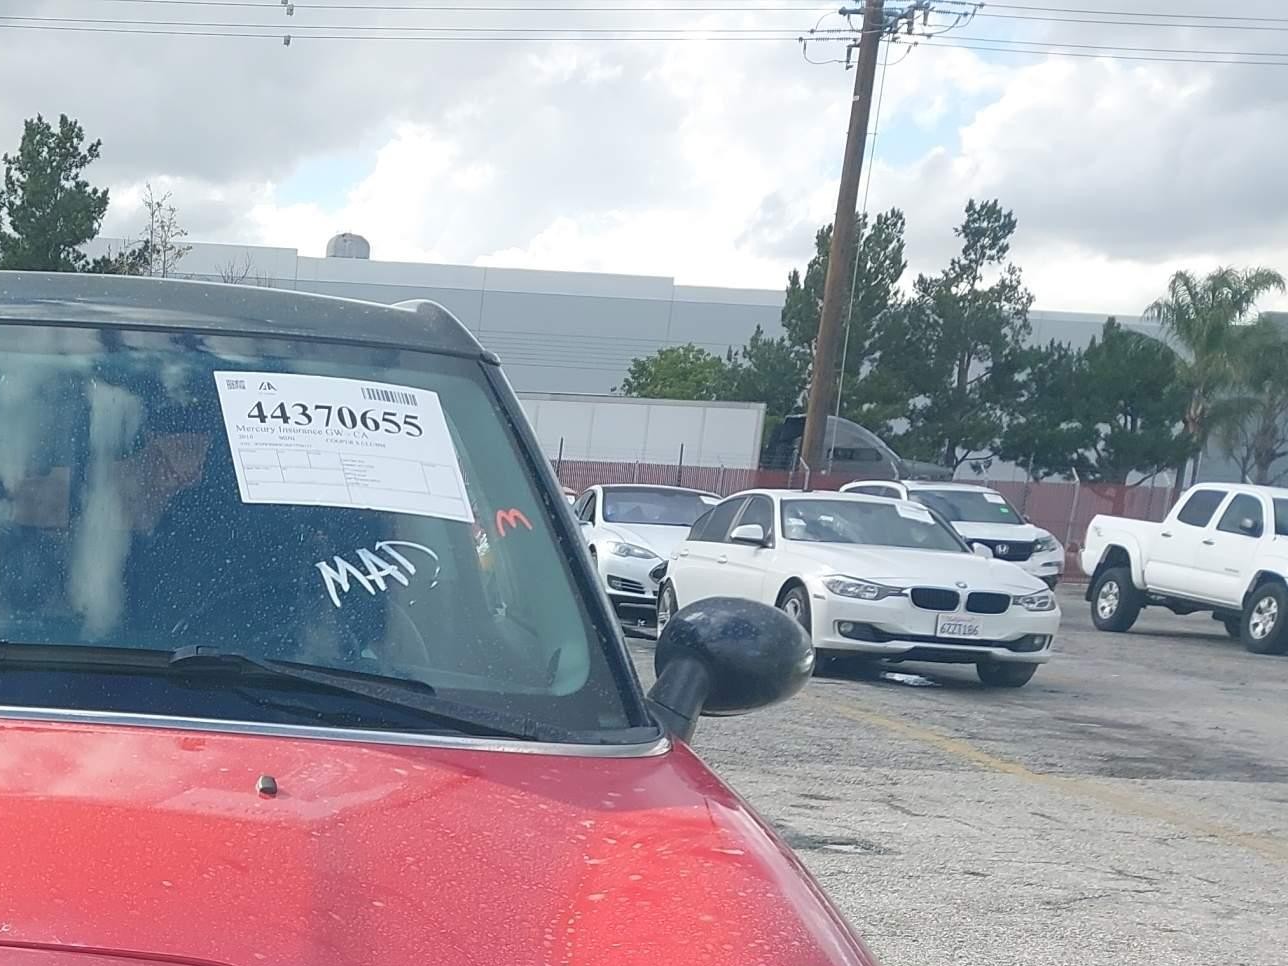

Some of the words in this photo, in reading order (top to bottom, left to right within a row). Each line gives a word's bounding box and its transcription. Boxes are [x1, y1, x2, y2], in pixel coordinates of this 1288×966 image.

[236, 424, 275, 433] Mercury
[278, 425, 322, 435] Insurance
[325, 428, 344, 437] GW
[353, 431, 369, 439] CA
[247, 400, 423, 438] 44370655
[315, 540, 441, 608] MAD
